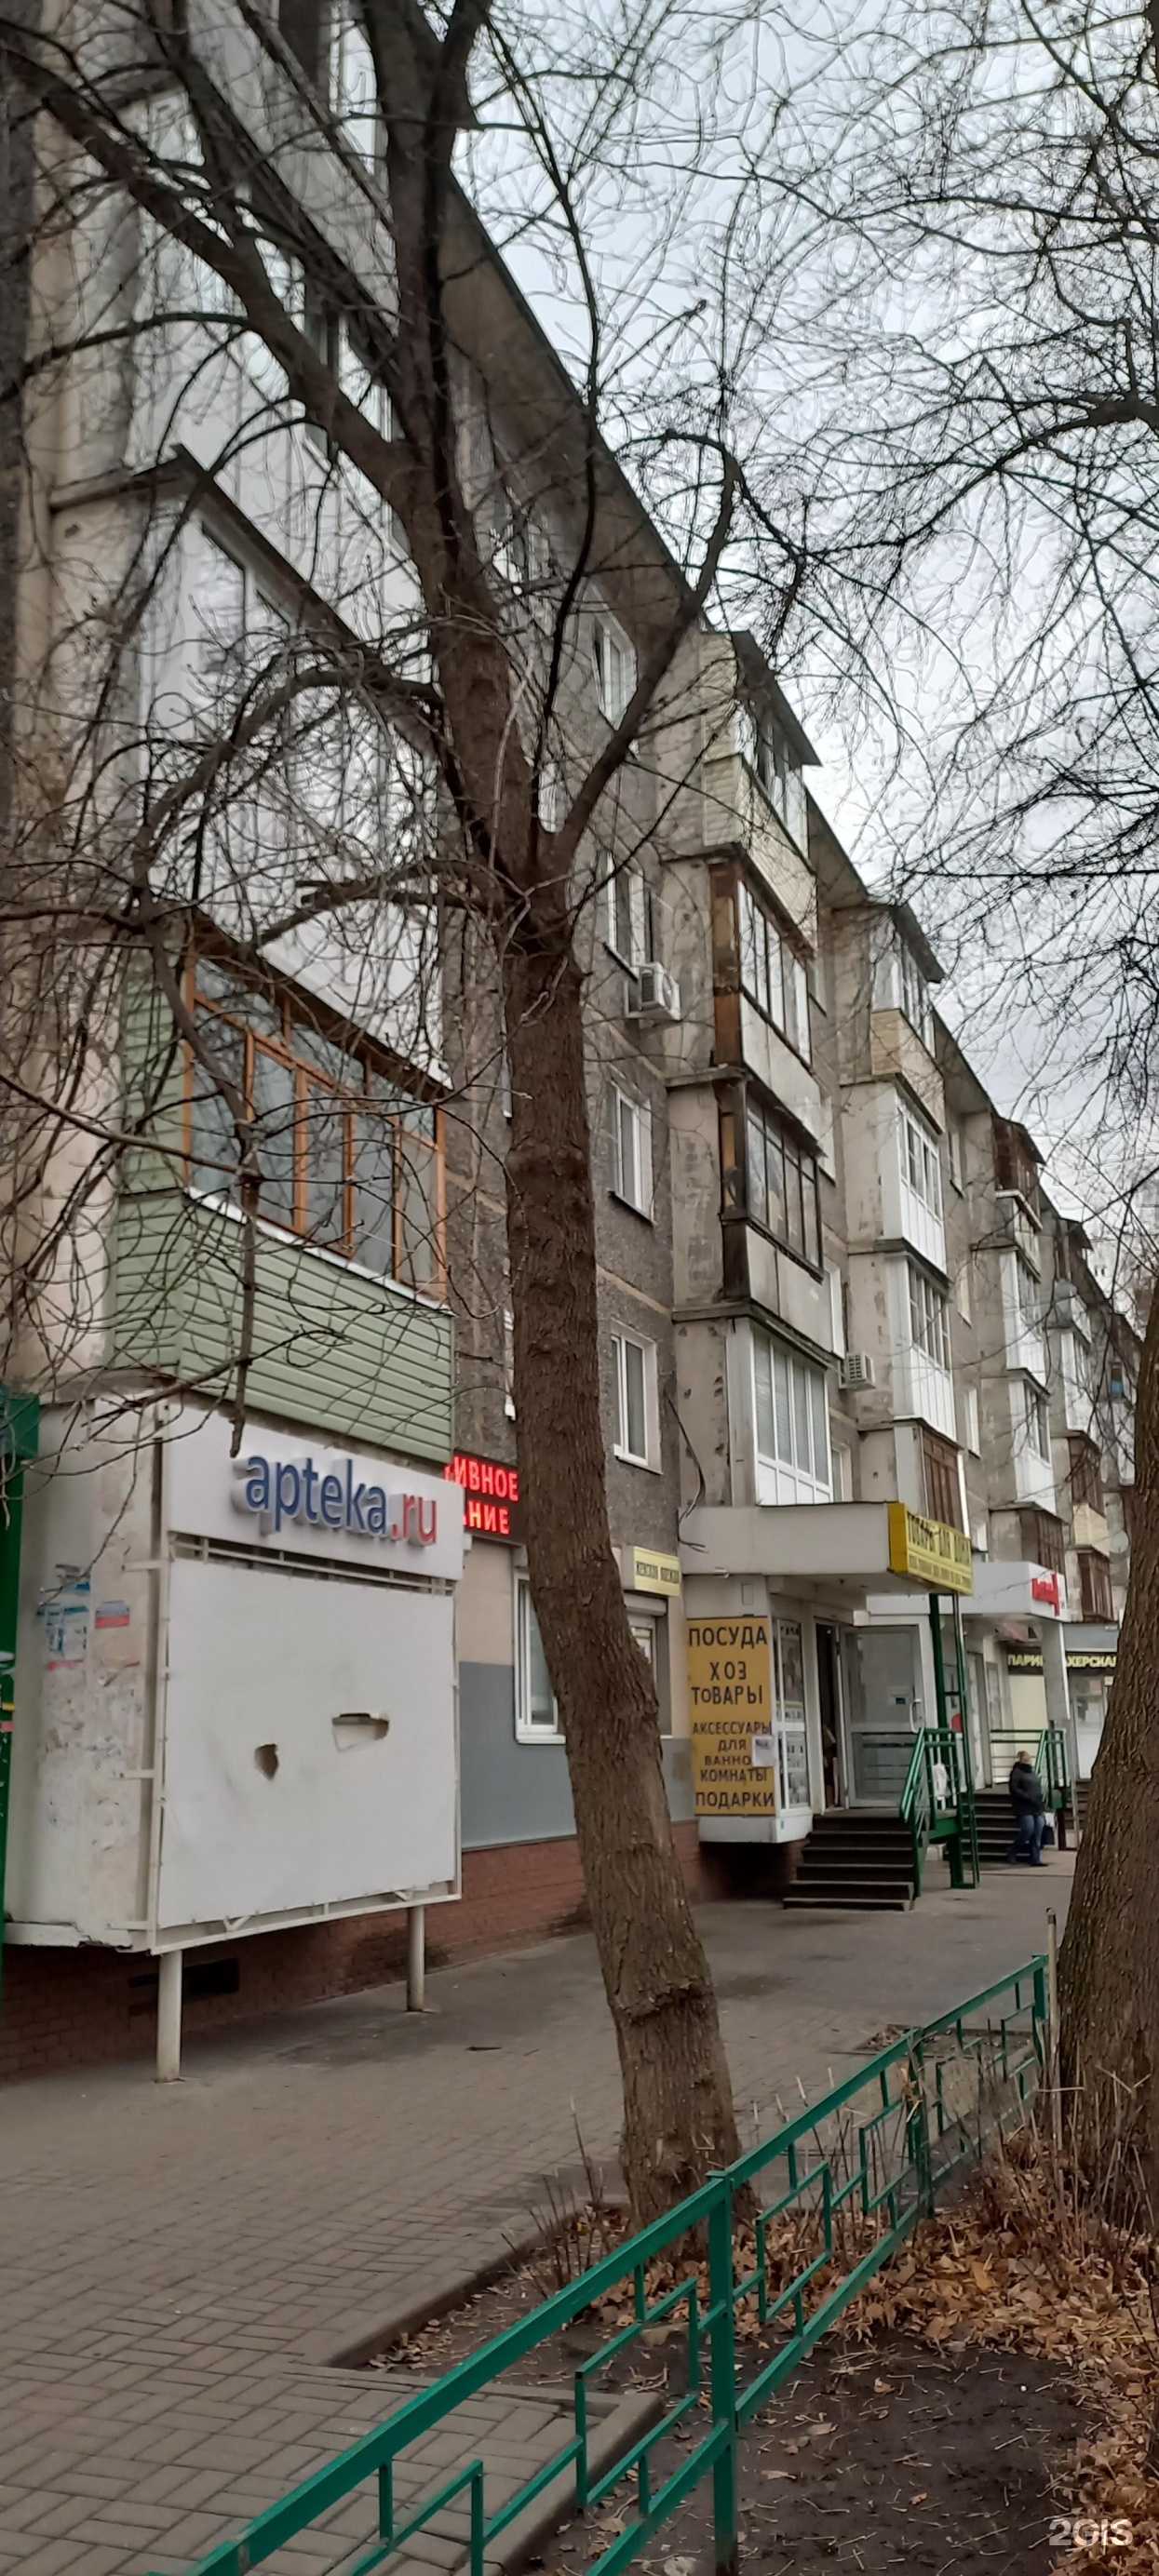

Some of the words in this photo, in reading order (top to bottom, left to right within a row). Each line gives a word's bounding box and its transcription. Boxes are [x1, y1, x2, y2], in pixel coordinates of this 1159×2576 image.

[245, 1456, 437, 1543] apteka.ru
[463, 1500, 509, 1535] НИЕ
[689, 1626, 767, 1649] ПОСУДА
[709, 1661, 747, 1681] ХОЗ
[693, 1721, 772, 1735] АКСЕССУАРЫ
[718, 1739, 747, 1751] ДЛЯ
[704, 1755, 752, 1765] ВАННО
[700, 1768, 767, 1782] КОМНАТЫ
[695, 1791, 775, 1809] ПОДАРКИ
